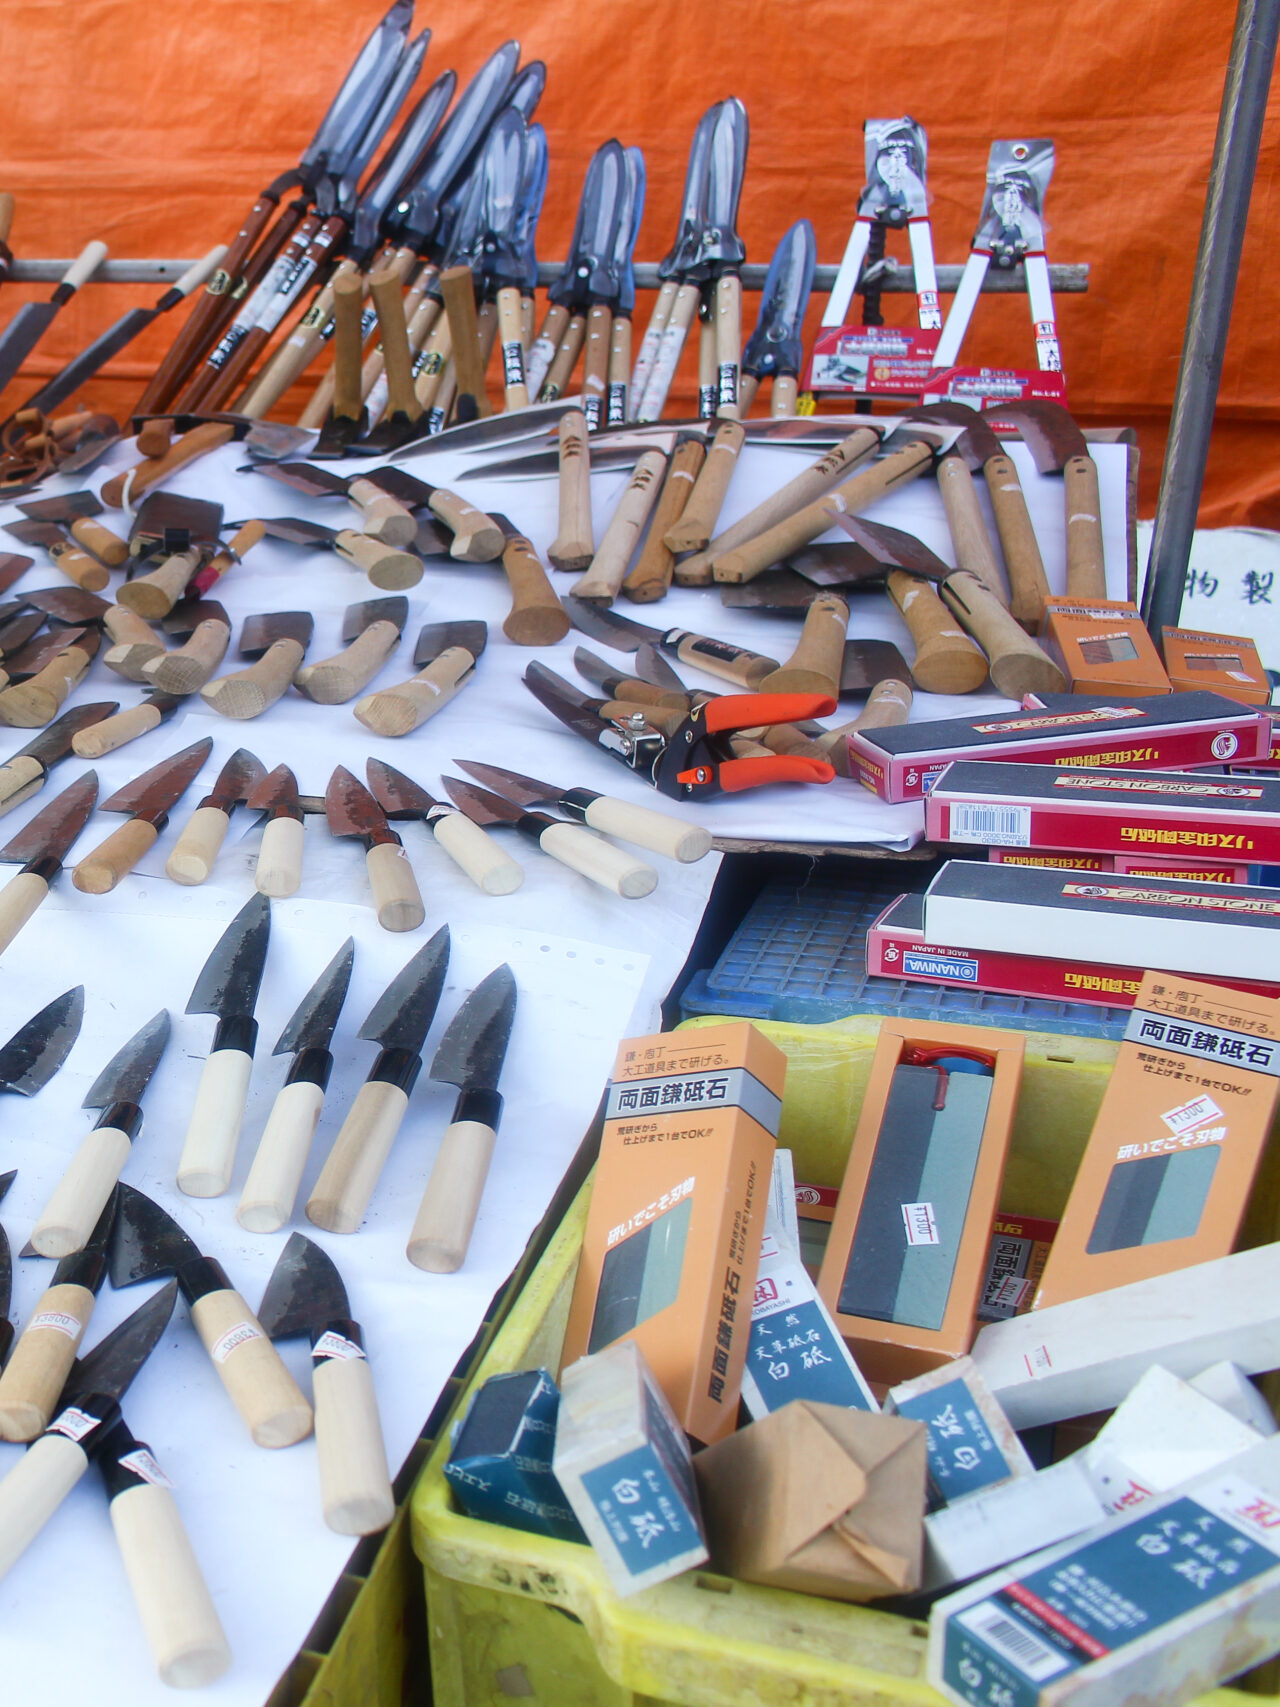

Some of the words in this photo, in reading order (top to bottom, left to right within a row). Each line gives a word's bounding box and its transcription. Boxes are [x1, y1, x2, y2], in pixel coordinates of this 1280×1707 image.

[1065, 777, 1126, 790] STONE
[1130, 782, 1209, 793] CARBON
[1120, 827, 1255, 850] リス印金剛砥石
[1117, 889, 1202, 905] CARBON
[1208, 899, 1276, 911] STONE
[912, 944, 935, 954] JAPAN
[909, 960, 961, 976] NANIWA
[1139, 1018, 1274, 1067] 両面鎌砥石
[617, 1077, 729, 1111] 両面鎌砥石
[224, 1328, 257, 1350] ¥3800
[708, 1266, 741, 1404] 両面鎌砥石
[755, 1328, 821, 1361] 天草砥石
